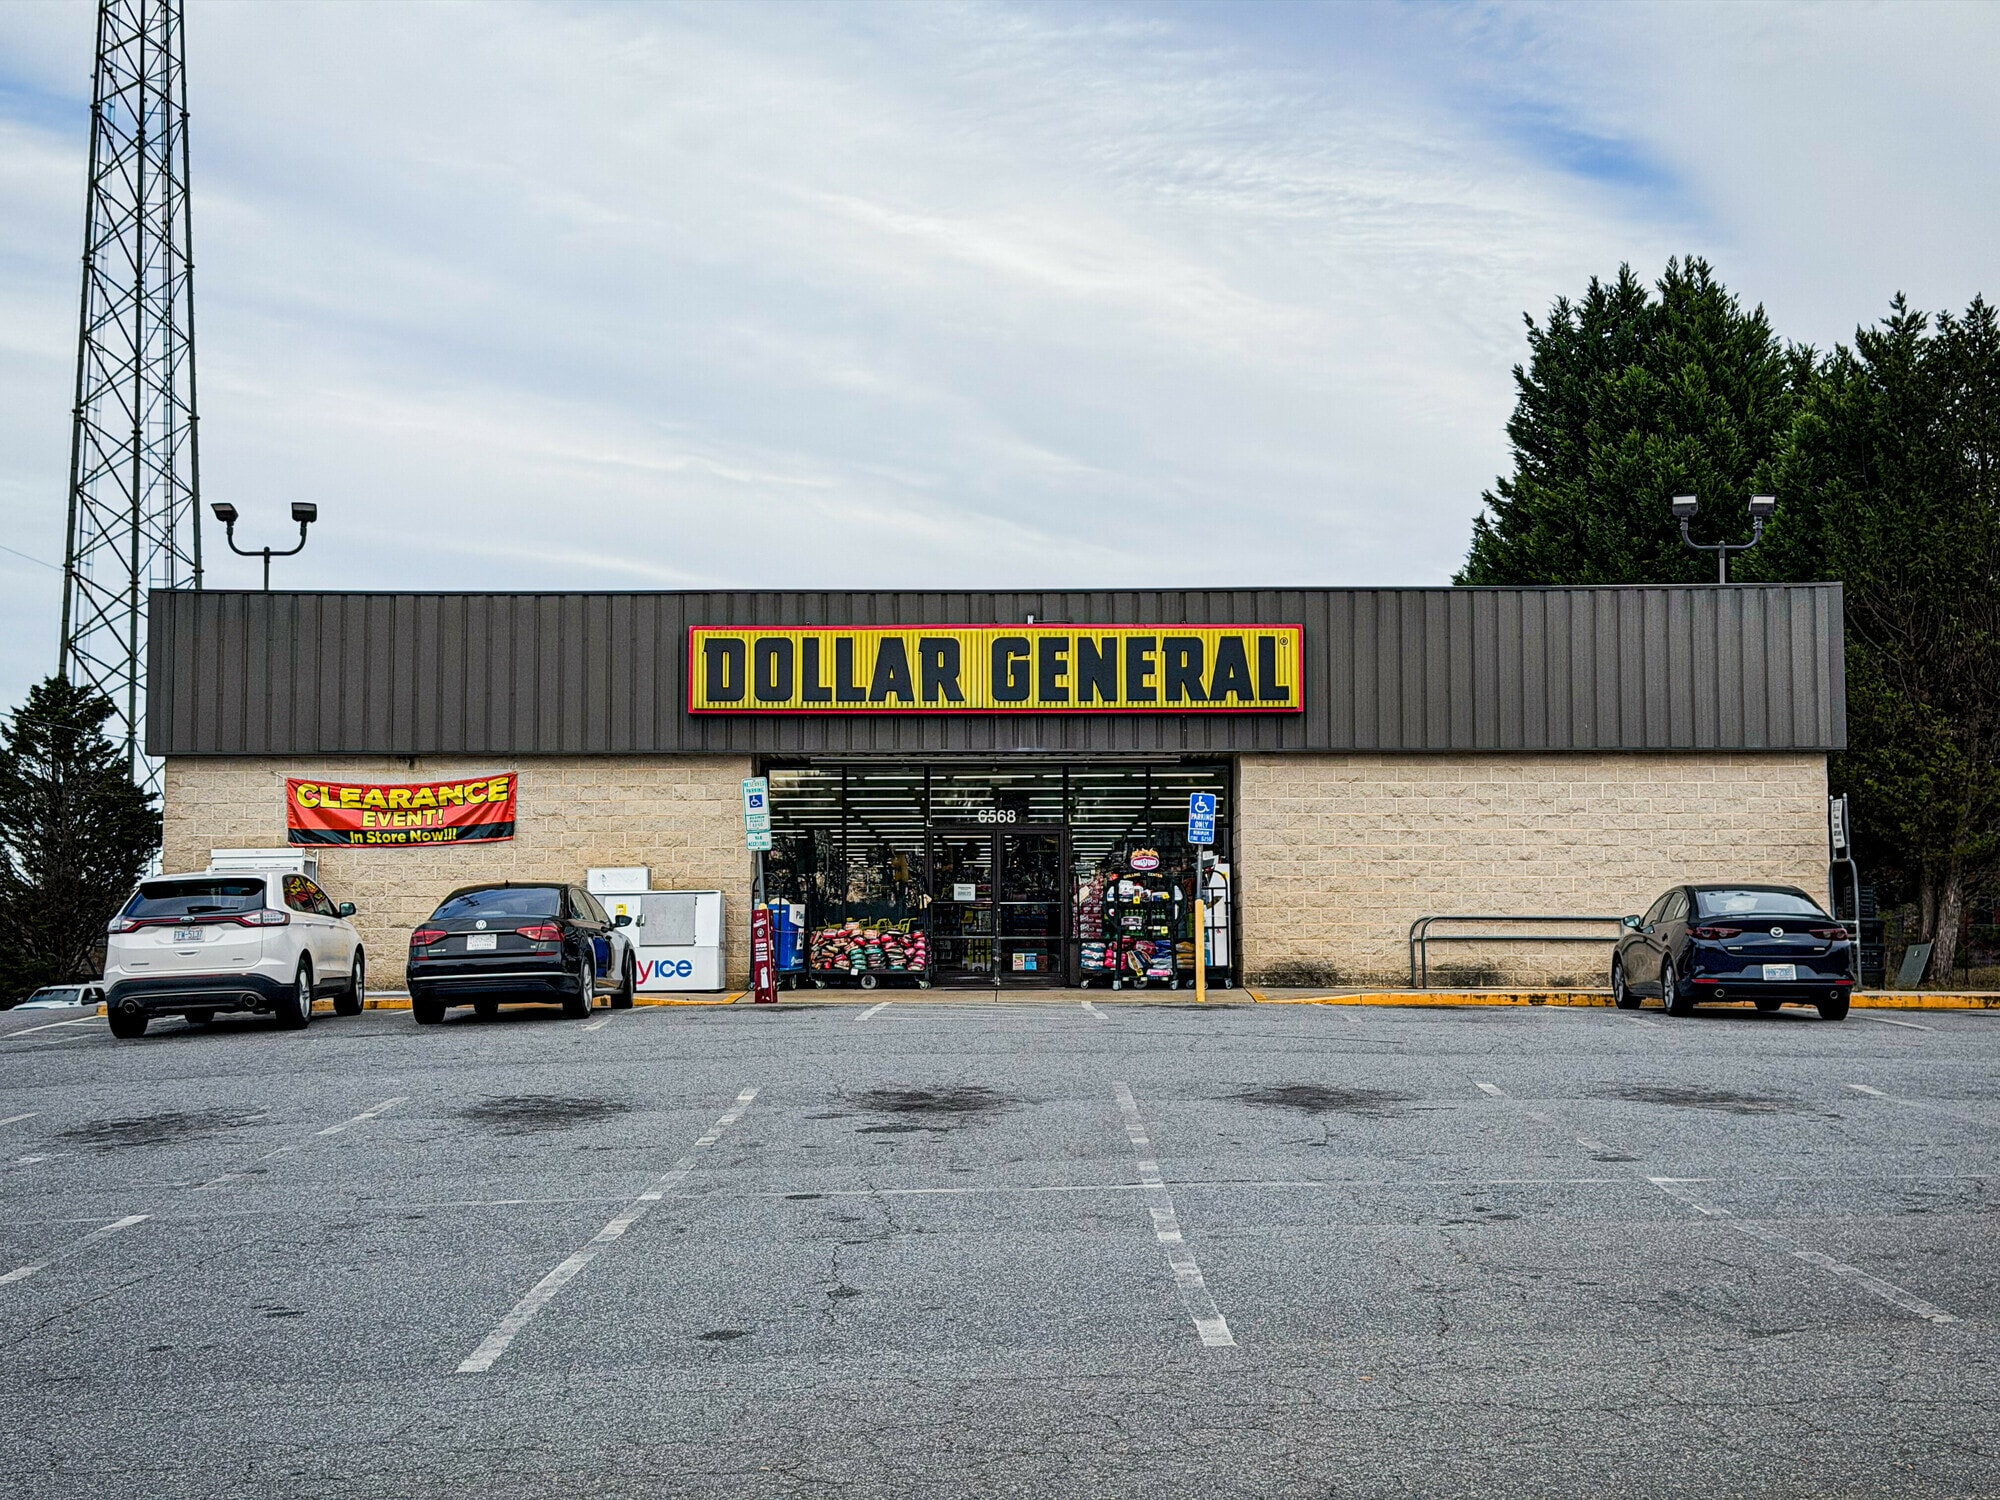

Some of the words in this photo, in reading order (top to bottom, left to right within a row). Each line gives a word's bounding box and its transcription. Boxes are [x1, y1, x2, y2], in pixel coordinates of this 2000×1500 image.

[703, 637, 966, 701] DOLLAR
[991, 636, 1290, 701] GENERAL
[296, 776, 509, 810] CLEARANCE
[361, 809, 443, 827] EVENT!
[978, 810, 1016, 823] 6568
[1190, 813, 1214, 821] PARKING
[350, 831, 363, 844] In
[366, 830, 407, 843] Store
[410, 828, 457, 842] Now!!!
